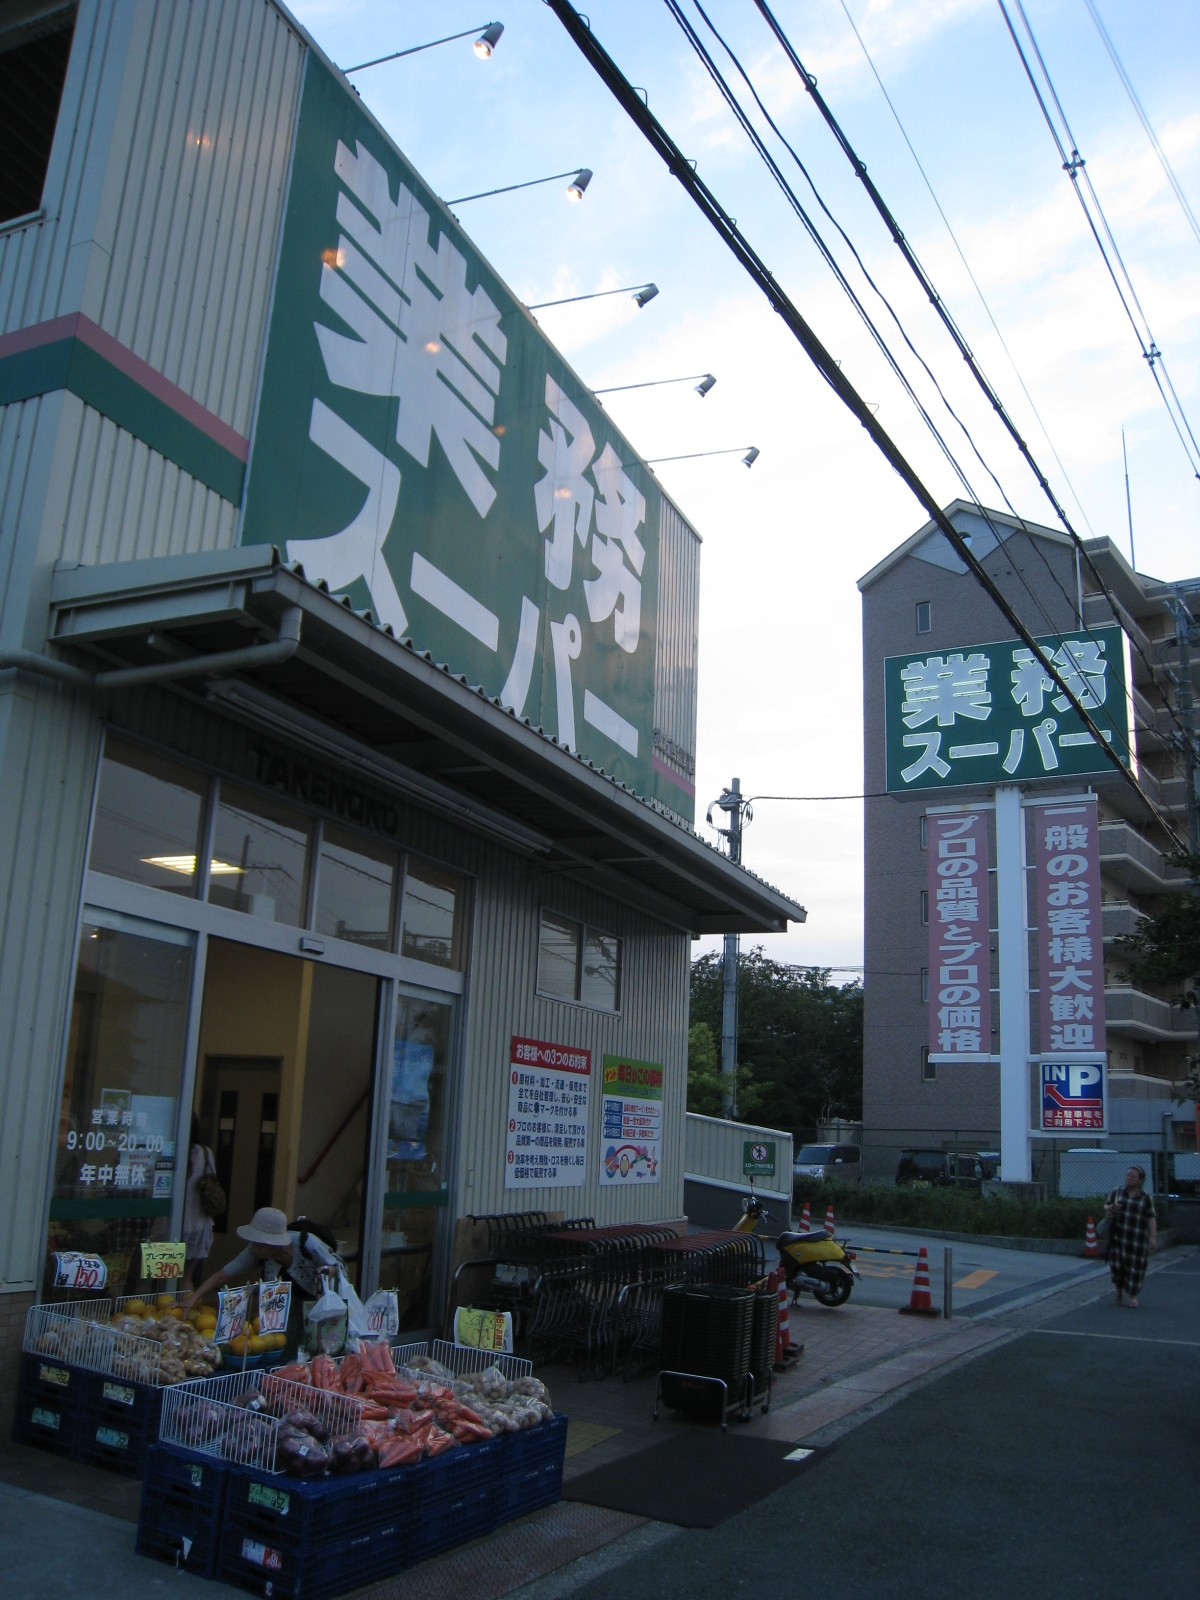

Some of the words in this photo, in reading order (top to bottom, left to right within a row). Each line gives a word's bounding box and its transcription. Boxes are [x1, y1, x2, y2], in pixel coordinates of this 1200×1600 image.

[313, 138, 647, 654] 業務
[286, 397, 639, 757] スーパー
[900, 640, 1107, 729] 業務
[900, 718, 1112, 784] スーパー
[251, 744, 398, 836] TAKENOKO
[936, 814, 982, 1053] プロの品質とプロの価格
[1043, 806, 1095, 1051] 一般のお客様大歓迎
[92, 1108, 148, 1128] 営業時間
[1044, 1065, 1066, 1081] IN
[1069, 1065, 1101, 1097] P
[1044, 1110, 1102, 1118] 屋上駐車場を
[1044, 1118, 1102, 1127] ご利用下さい
[79, 1163, 146, 1186] 年中無休
